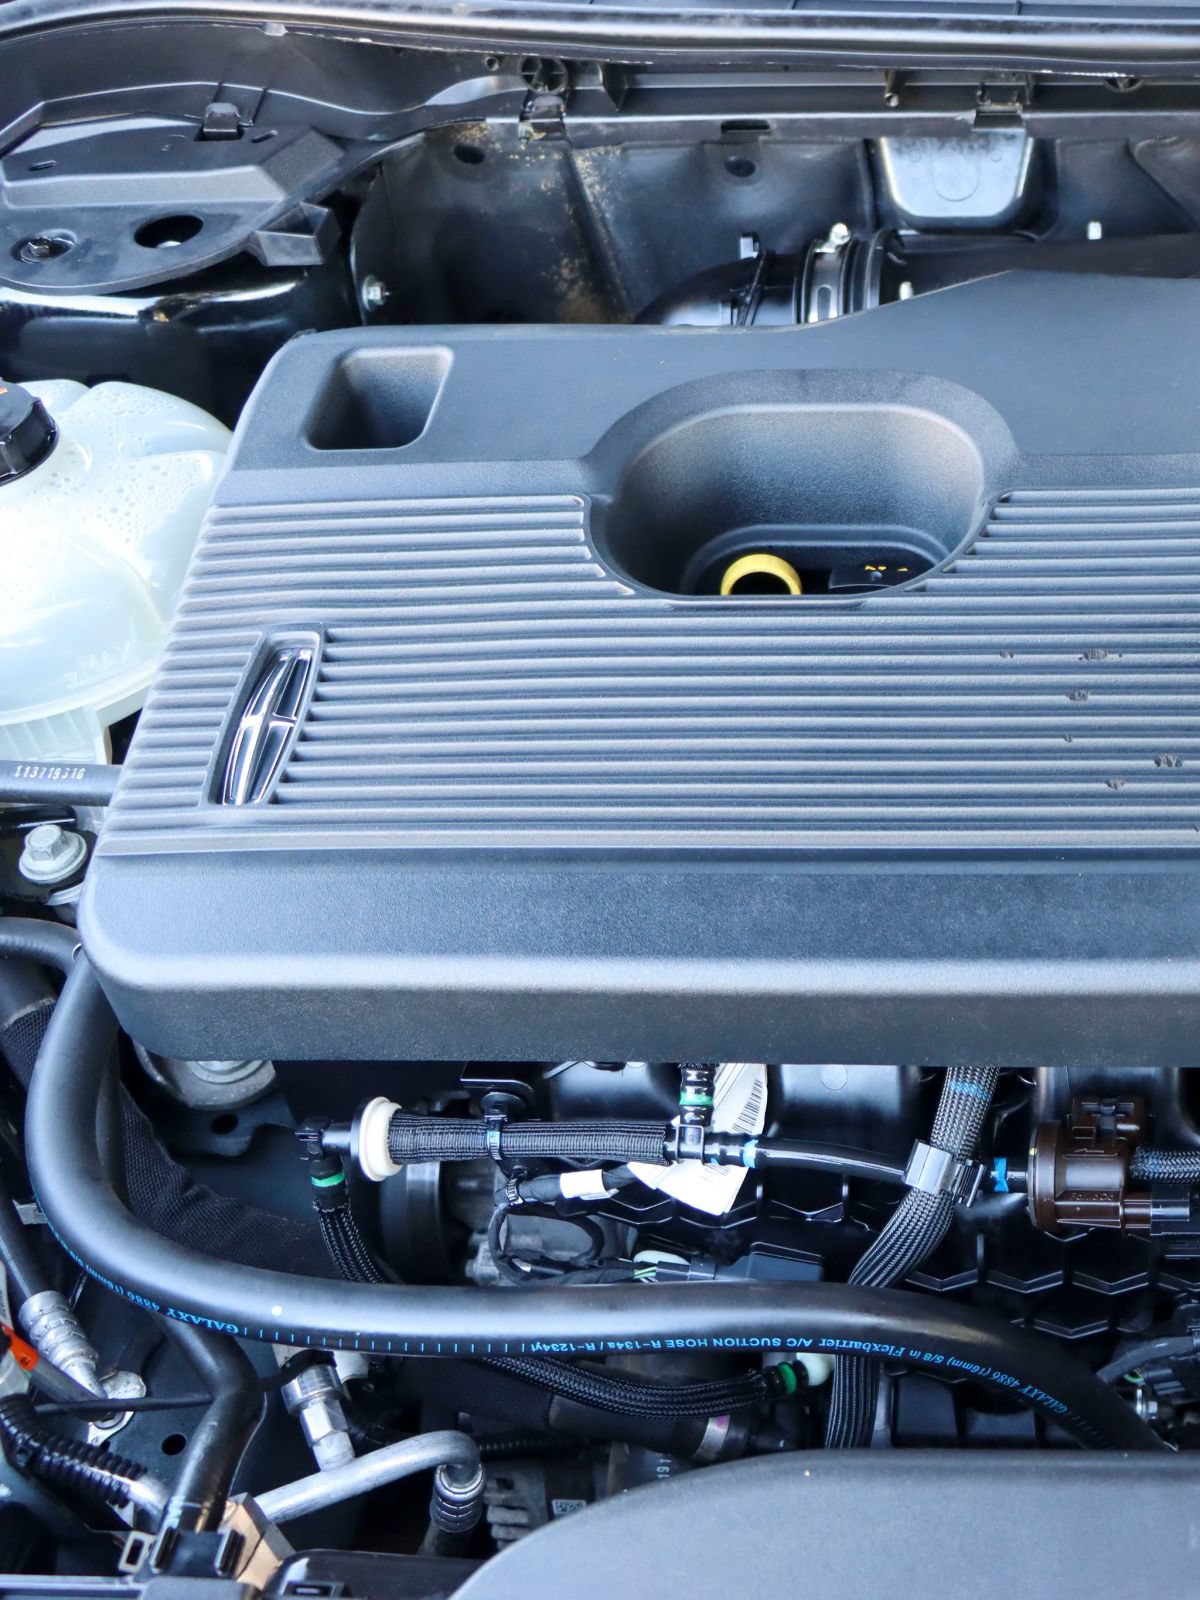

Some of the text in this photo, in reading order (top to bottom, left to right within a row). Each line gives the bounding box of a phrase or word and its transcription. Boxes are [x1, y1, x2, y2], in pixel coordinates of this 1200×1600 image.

[127, 1291, 161, 1311] 4886
[166, 1306, 239, 1335] GALAXY
[608, 1340, 662, 1350] R-134a
[665, 1338, 708, 1349] HOSE
[713, 1337, 782, 1347] SUCTION
[787, 1337, 813, 1348] A/C
[818, 1336, 906, 1359] Flexbarrier
[908, 1348, 922, 1359] in
[923, 1351, 944, 1364] 5/8
[947, 1355, 992, 1377] (16mm)
[992, 1371, 1021, 1389] 4886
[1020, 1383, 1070, 1414] GALAXY
